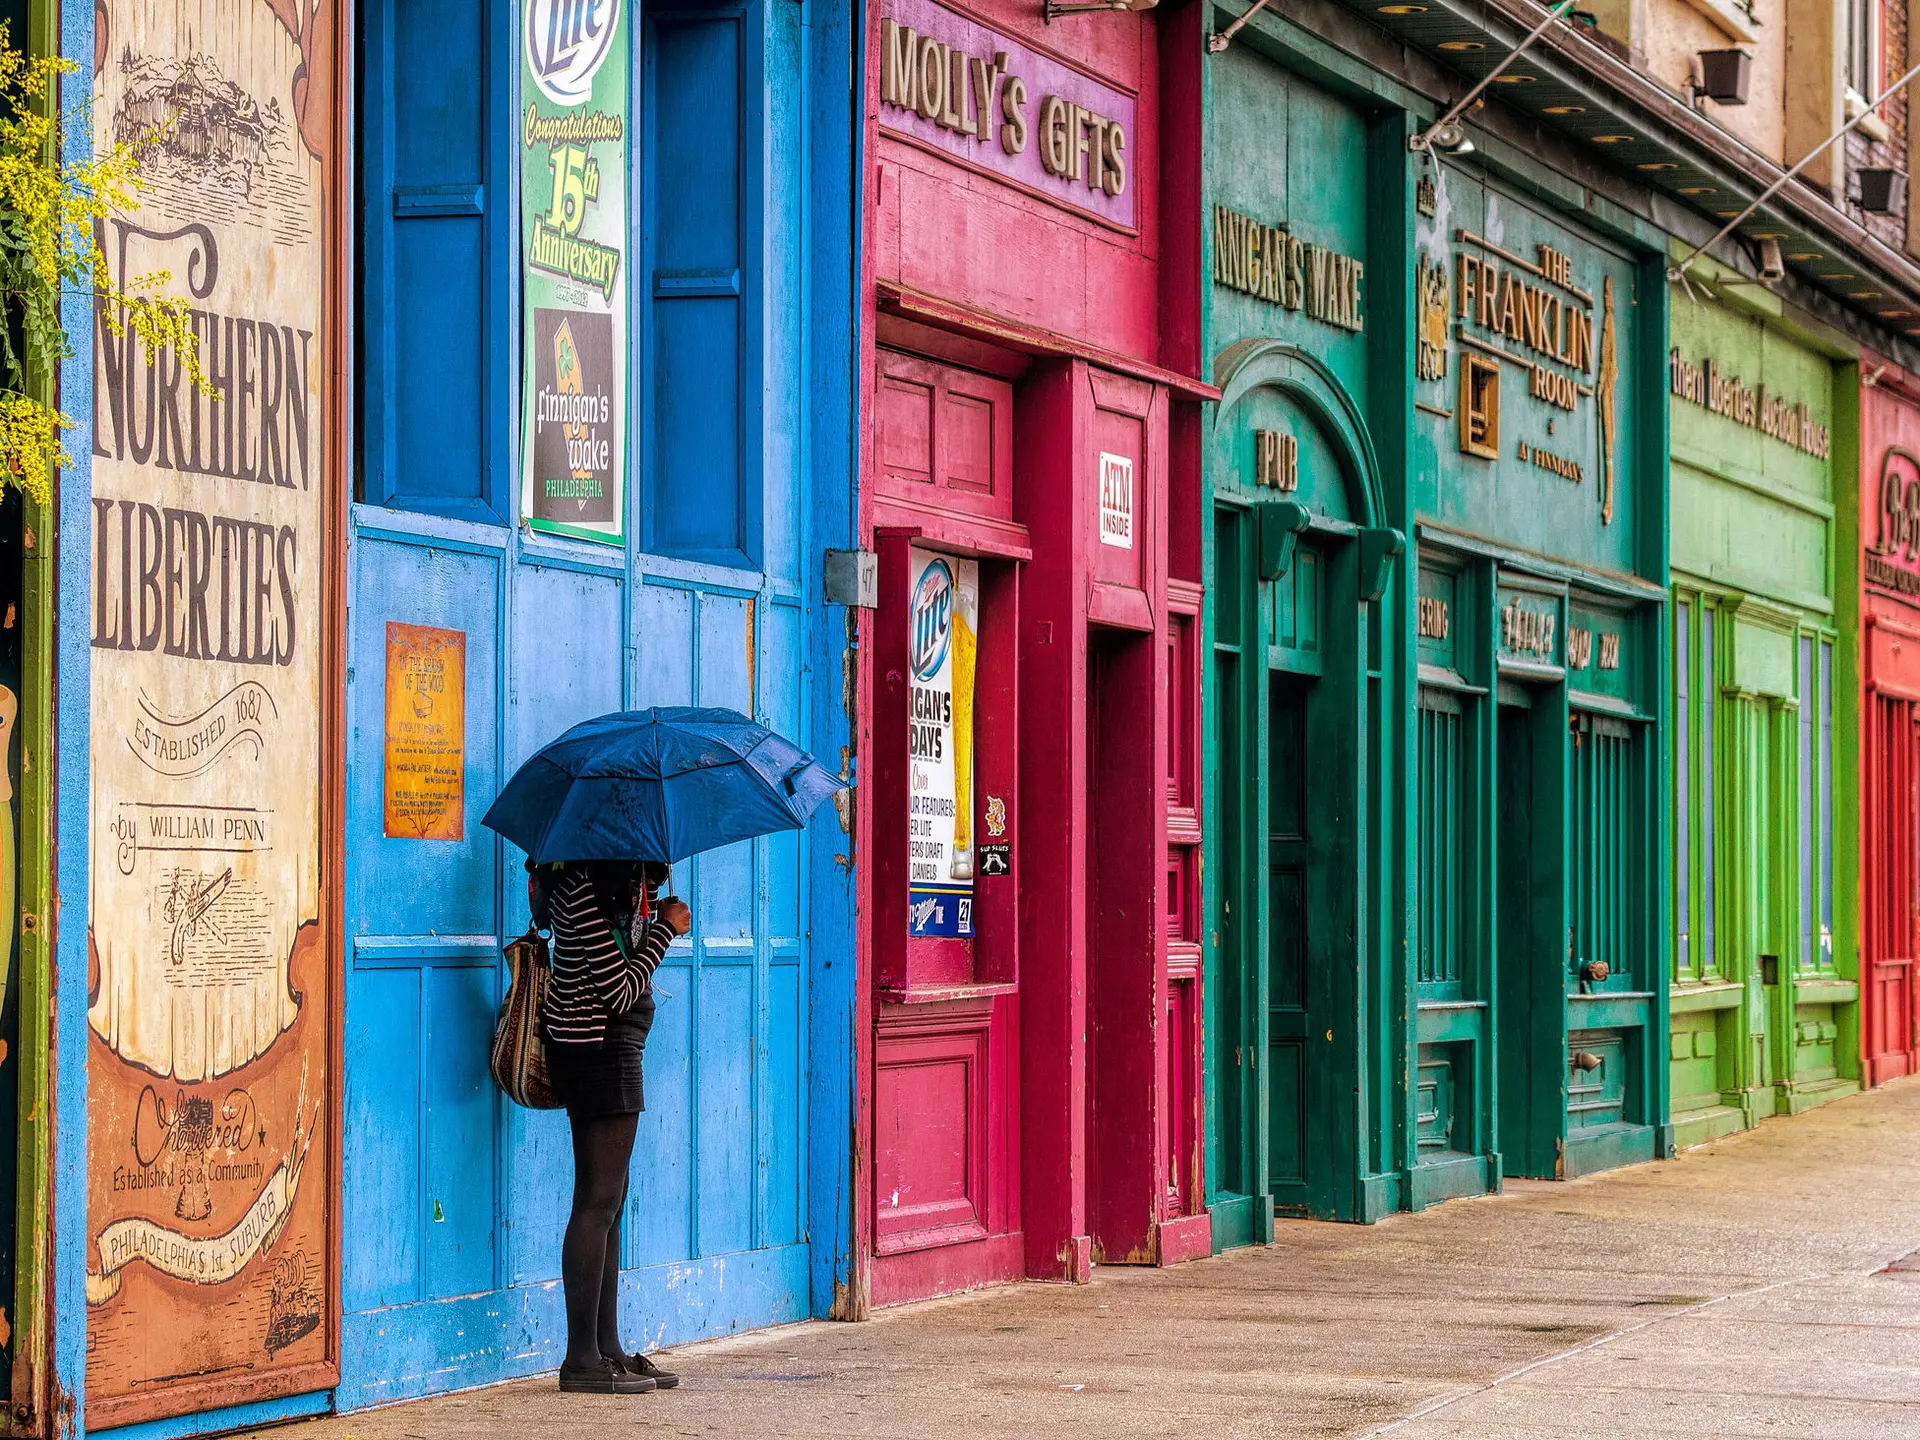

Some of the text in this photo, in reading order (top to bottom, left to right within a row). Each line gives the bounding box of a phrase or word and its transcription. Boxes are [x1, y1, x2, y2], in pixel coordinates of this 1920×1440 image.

[525, 102, 622, 149] Congratulations
[881, 17, 1126, 197] MOLLY'S GIFTS
[546, 143, 600, 238] 15th
[529, 216, 619, 301] Anniversary
[1537, 244, 1572, 286] THE
[1304, 242, 1363, 332] WAKE
[1456, 251, 1593, 374] FRANKLIN
[92, 215, 313, 492] NORTHERN
[537, 384, 609, 434] finnigan's
[1529, 363, 1578, 411] ROOM
[568, 428, 609, 472] wake
[1256, 428, 1298, 492] PUB
[545, 479, 603, 499] PHILADELPHIA
[1103, 460, 1130, 515] ATM
[1103, 511, 1129, 538] INSIDE
[91, 498, 297, 667] LIBERTIES
[915, 583, 950, 681] Lite
[134, 689, 262, 761] ESTABLISHED 1682
[110, 814, 265, 876] by WILLIAM PENN
[920, 819, 932, 837] LITE
[925, 841, 944, 860] DRAFT
[912, 862, 937, 880] DANIELS
[960, 901, 970, 922] 21
[113, 1165, 174, 1191] Established
[179, 1172, 193, 1185] as
[208, 1157, 265, 1192] Community
[110, 1229, 205, 1274] PHILADELPHIA'S
[229, 1191, 277, 1264] SUBURB
